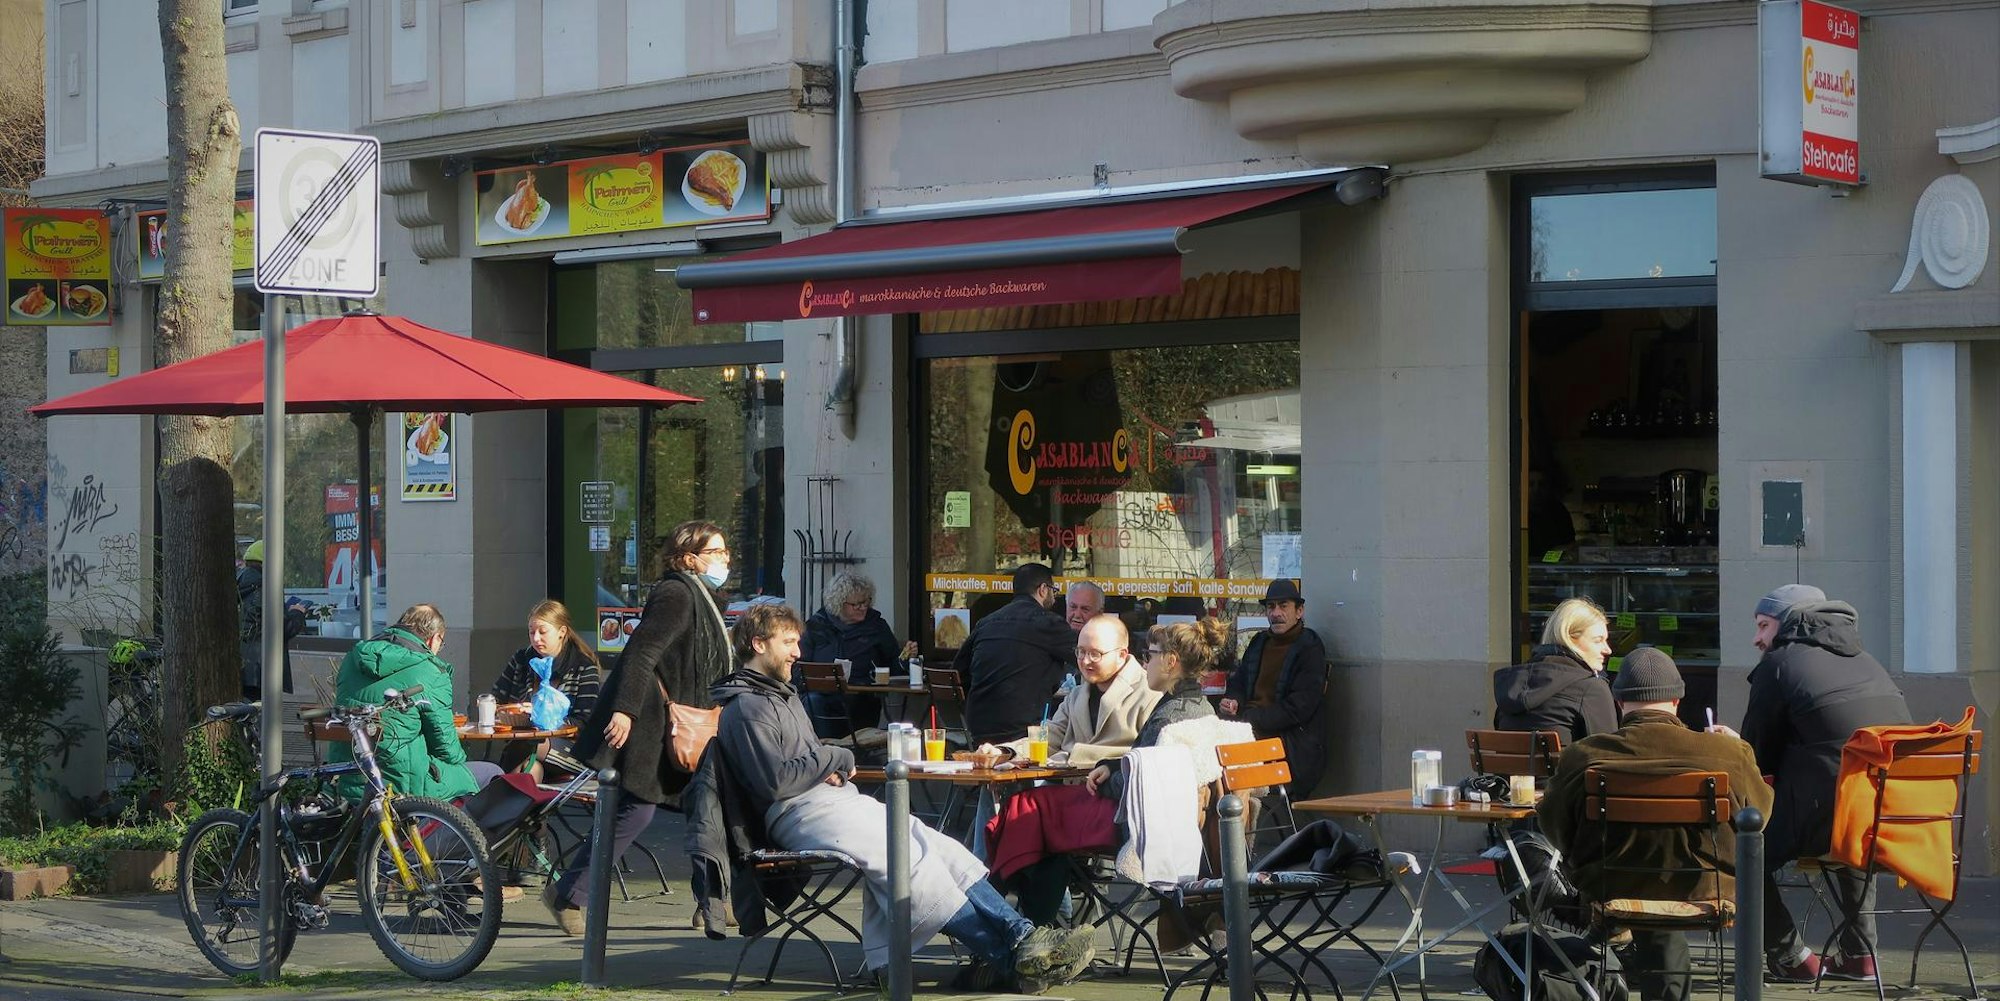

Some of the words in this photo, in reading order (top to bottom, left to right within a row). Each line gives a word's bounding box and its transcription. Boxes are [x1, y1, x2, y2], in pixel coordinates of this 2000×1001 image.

[1804, 140, 1856, 176] Stehcafé
[594, 184, 651, 199] Palmen
[608, 196, 628, 207] Grill
[33, 235, 97, 247] Palmen
[288, 257, 347, 283] ZONE
[859, 287, 933, 303] marokkanische
[933, 291, 941, 299] &
[944, 285, 989, 299] deutsche
[989, 281, 1047, 295] Backwaren
[1053, 489, 1123, 504] Backwaren
[335, 512, 356, 528] IMM
[335, 527, 359, 543] BESS
[932, 577, 989, 592] Milchkaffee,
[1117, 581, 1171, 595] gepresster
[1172, 581, 1196, 596] Saft,
[1199, 581, 1224, 594] kalte
